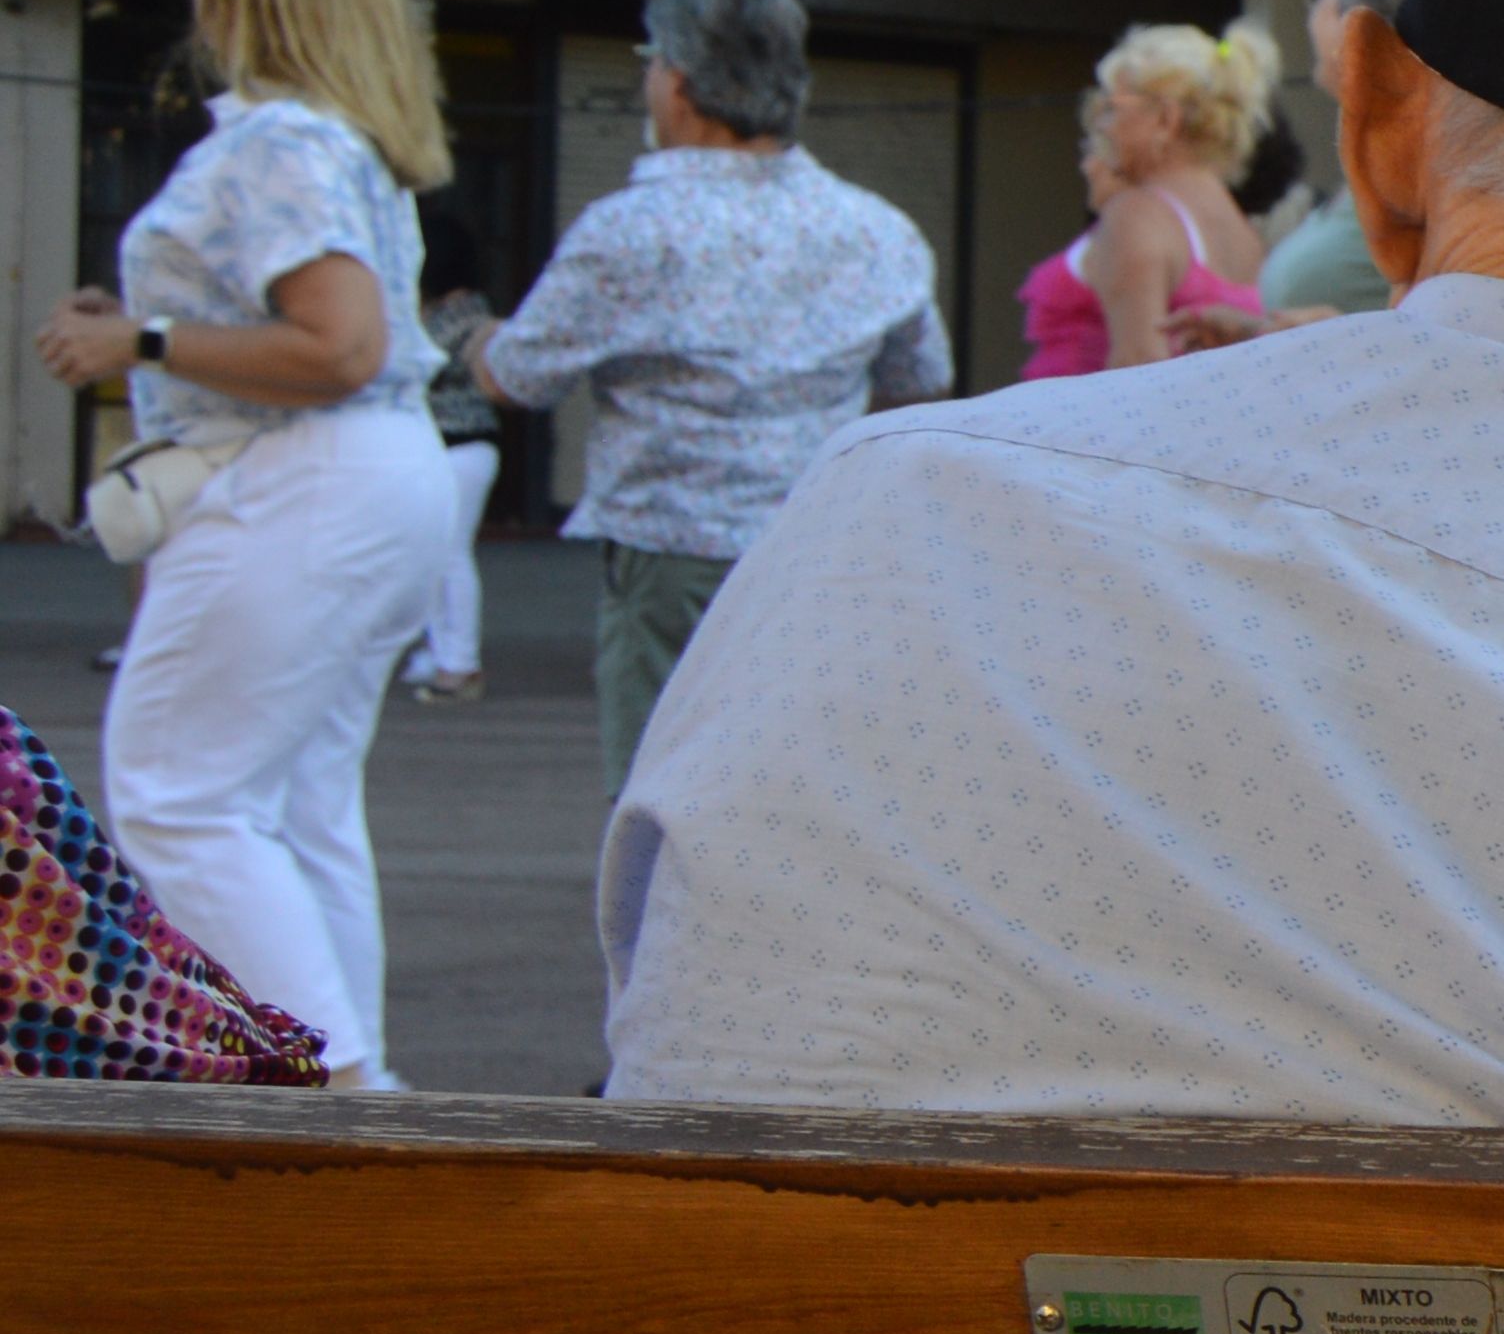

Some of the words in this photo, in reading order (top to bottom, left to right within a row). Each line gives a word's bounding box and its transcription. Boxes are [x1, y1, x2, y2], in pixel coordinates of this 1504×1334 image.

[1360, 1288, 1433, 1307] MIXTO
[1070, 1300, 1172, 1320] BENITO
[1326, 1311, 1376, 1324] Madera
[1380, 1314, 1457, 1327] procedente
[1461, 1316, 1478, 1327] de
